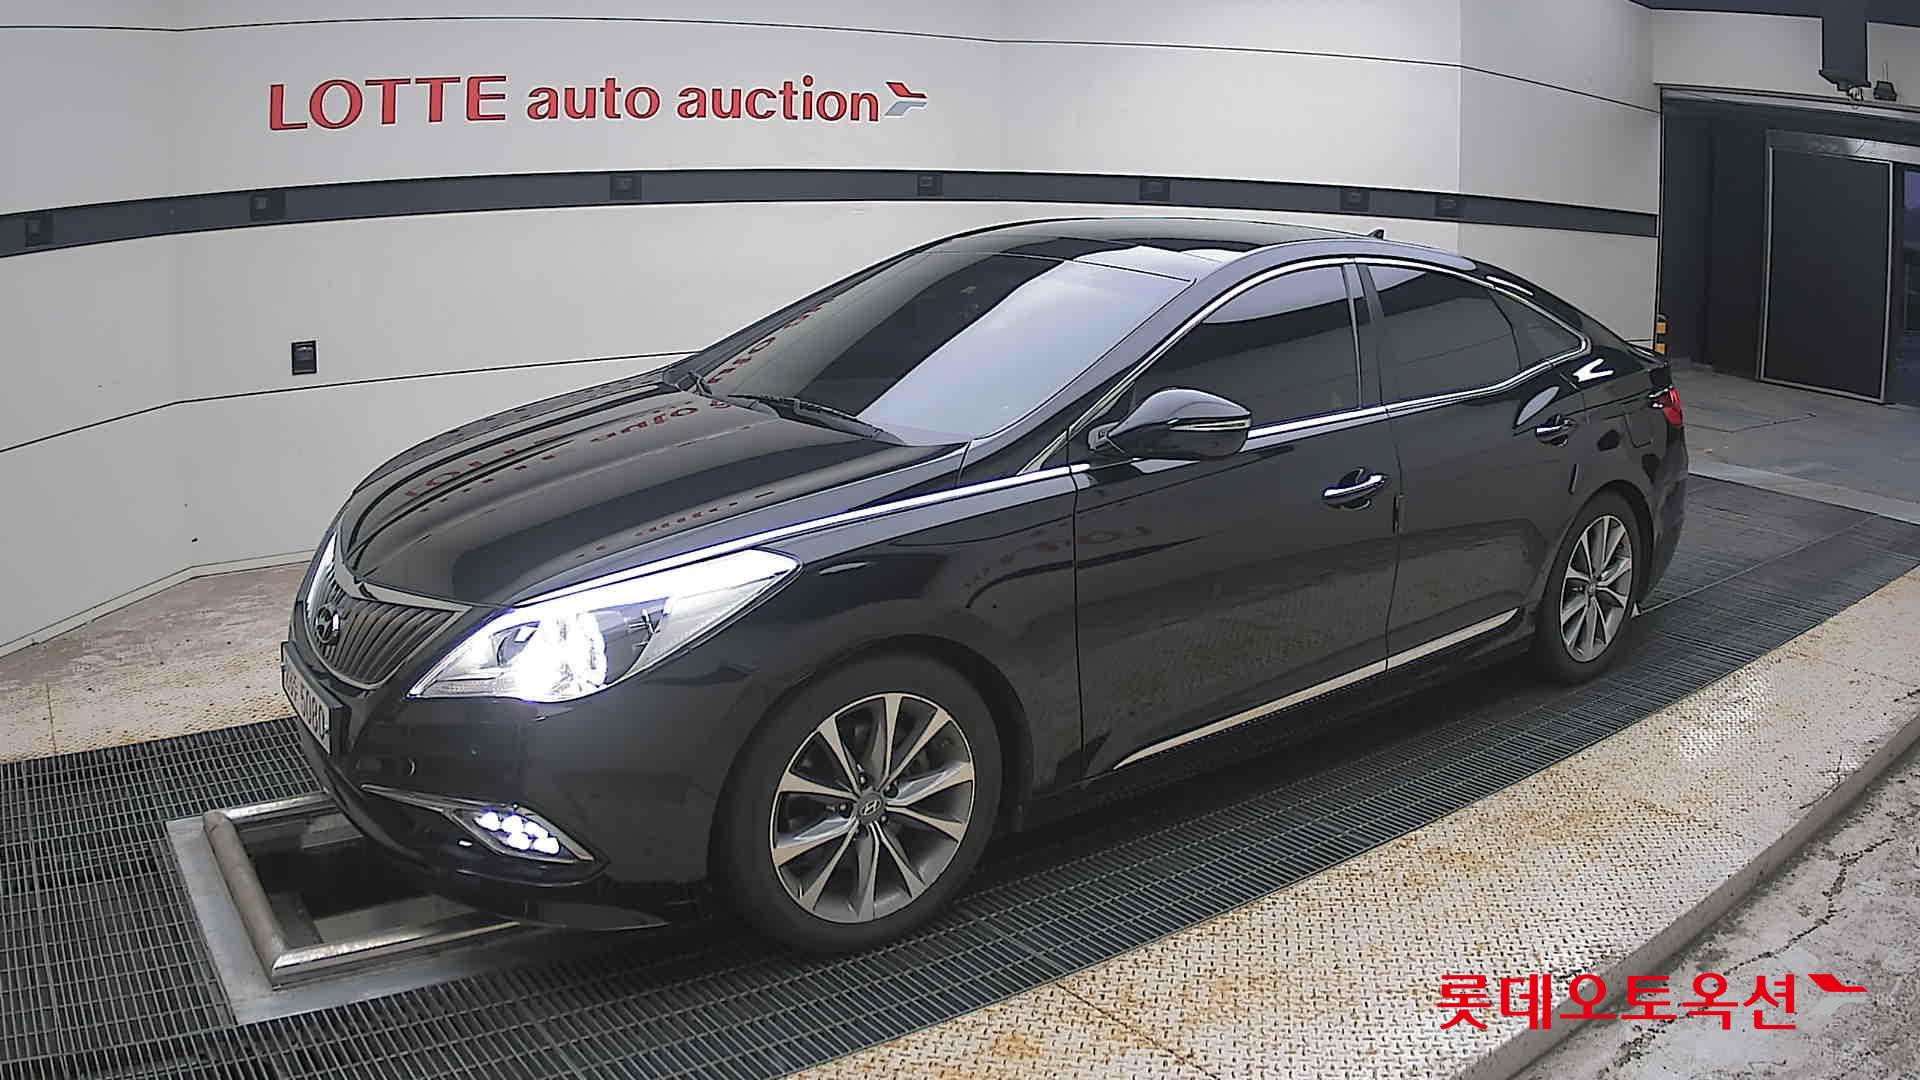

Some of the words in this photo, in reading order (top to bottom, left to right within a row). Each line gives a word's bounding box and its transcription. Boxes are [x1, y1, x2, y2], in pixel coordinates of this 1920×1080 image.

[269, 75, 506, 131] LOTTE
[526, 78, 662, 121] auto
[676, 75, 880, 122] auction
